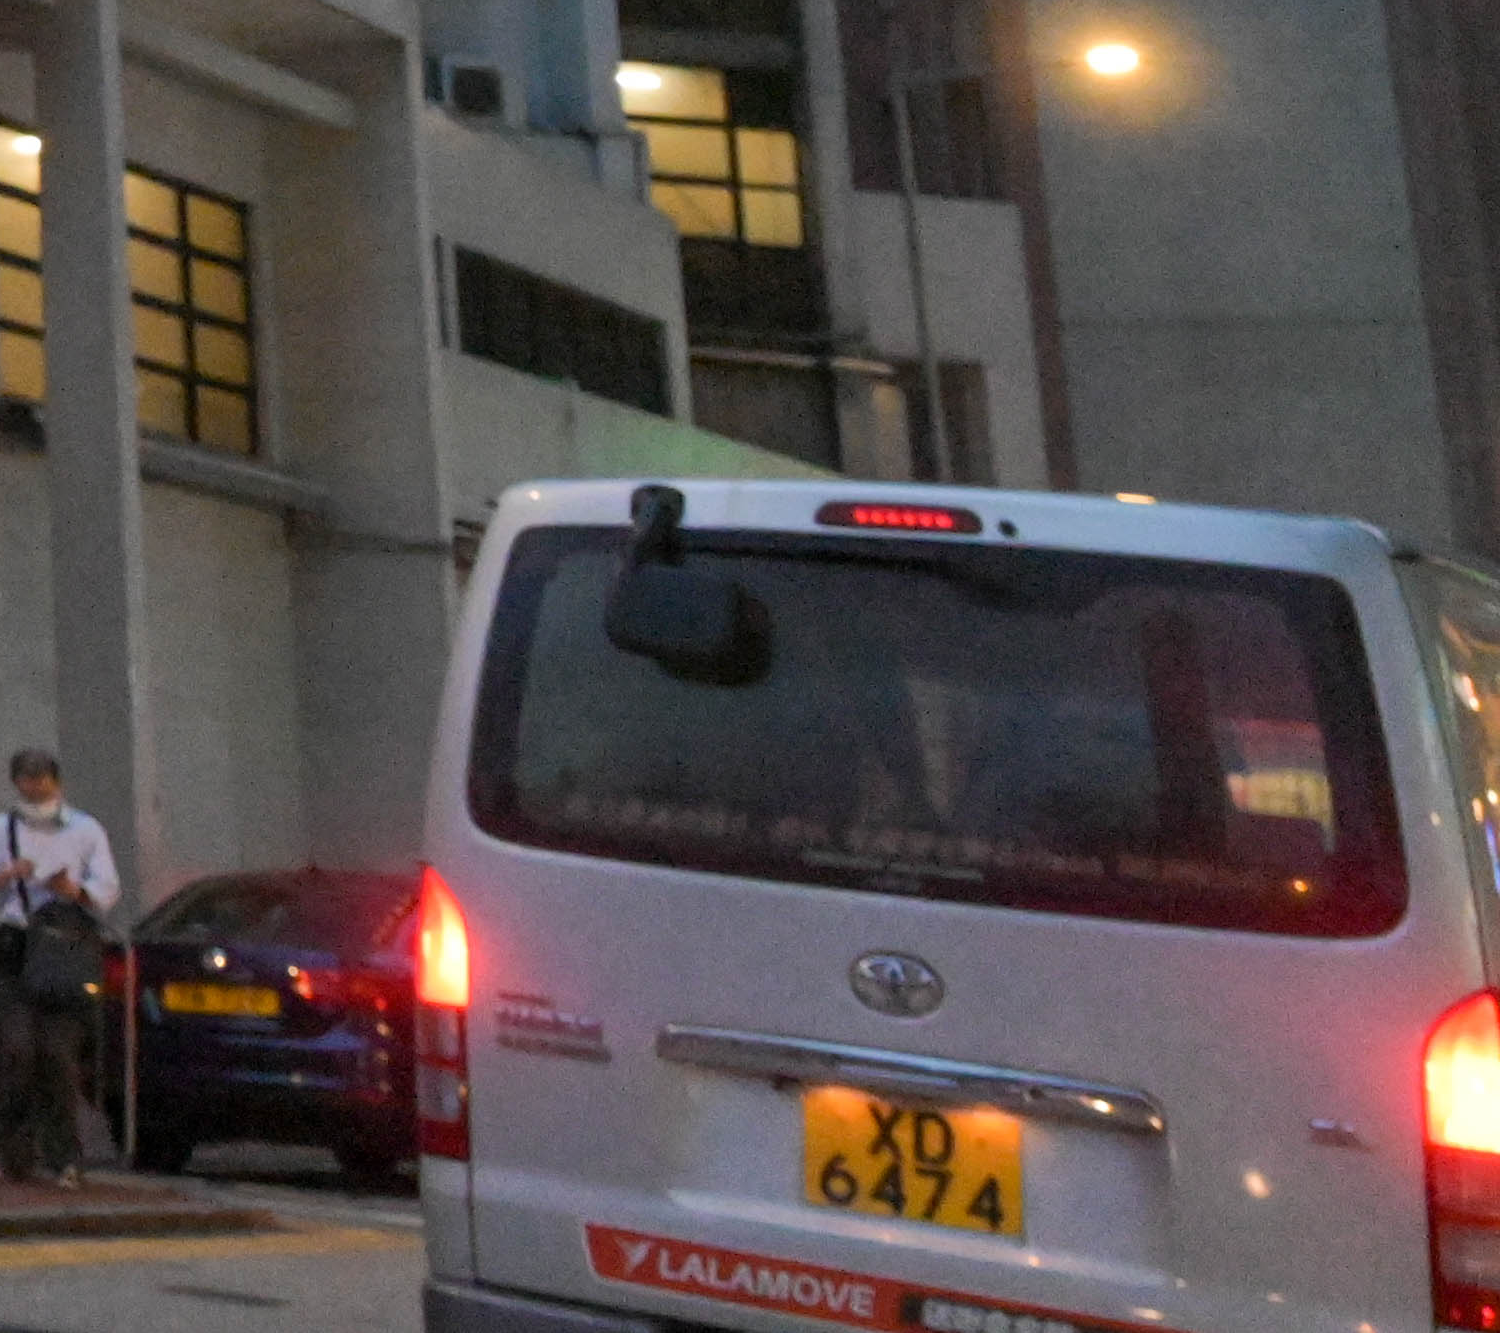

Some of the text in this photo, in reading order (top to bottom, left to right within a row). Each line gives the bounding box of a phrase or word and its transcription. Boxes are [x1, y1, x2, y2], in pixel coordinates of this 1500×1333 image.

[867, 1101, 955, 1169] XD
[818, 1154, 1007, 1231] 6474
[656, 1246, 877, 1320] LALAMOVE
